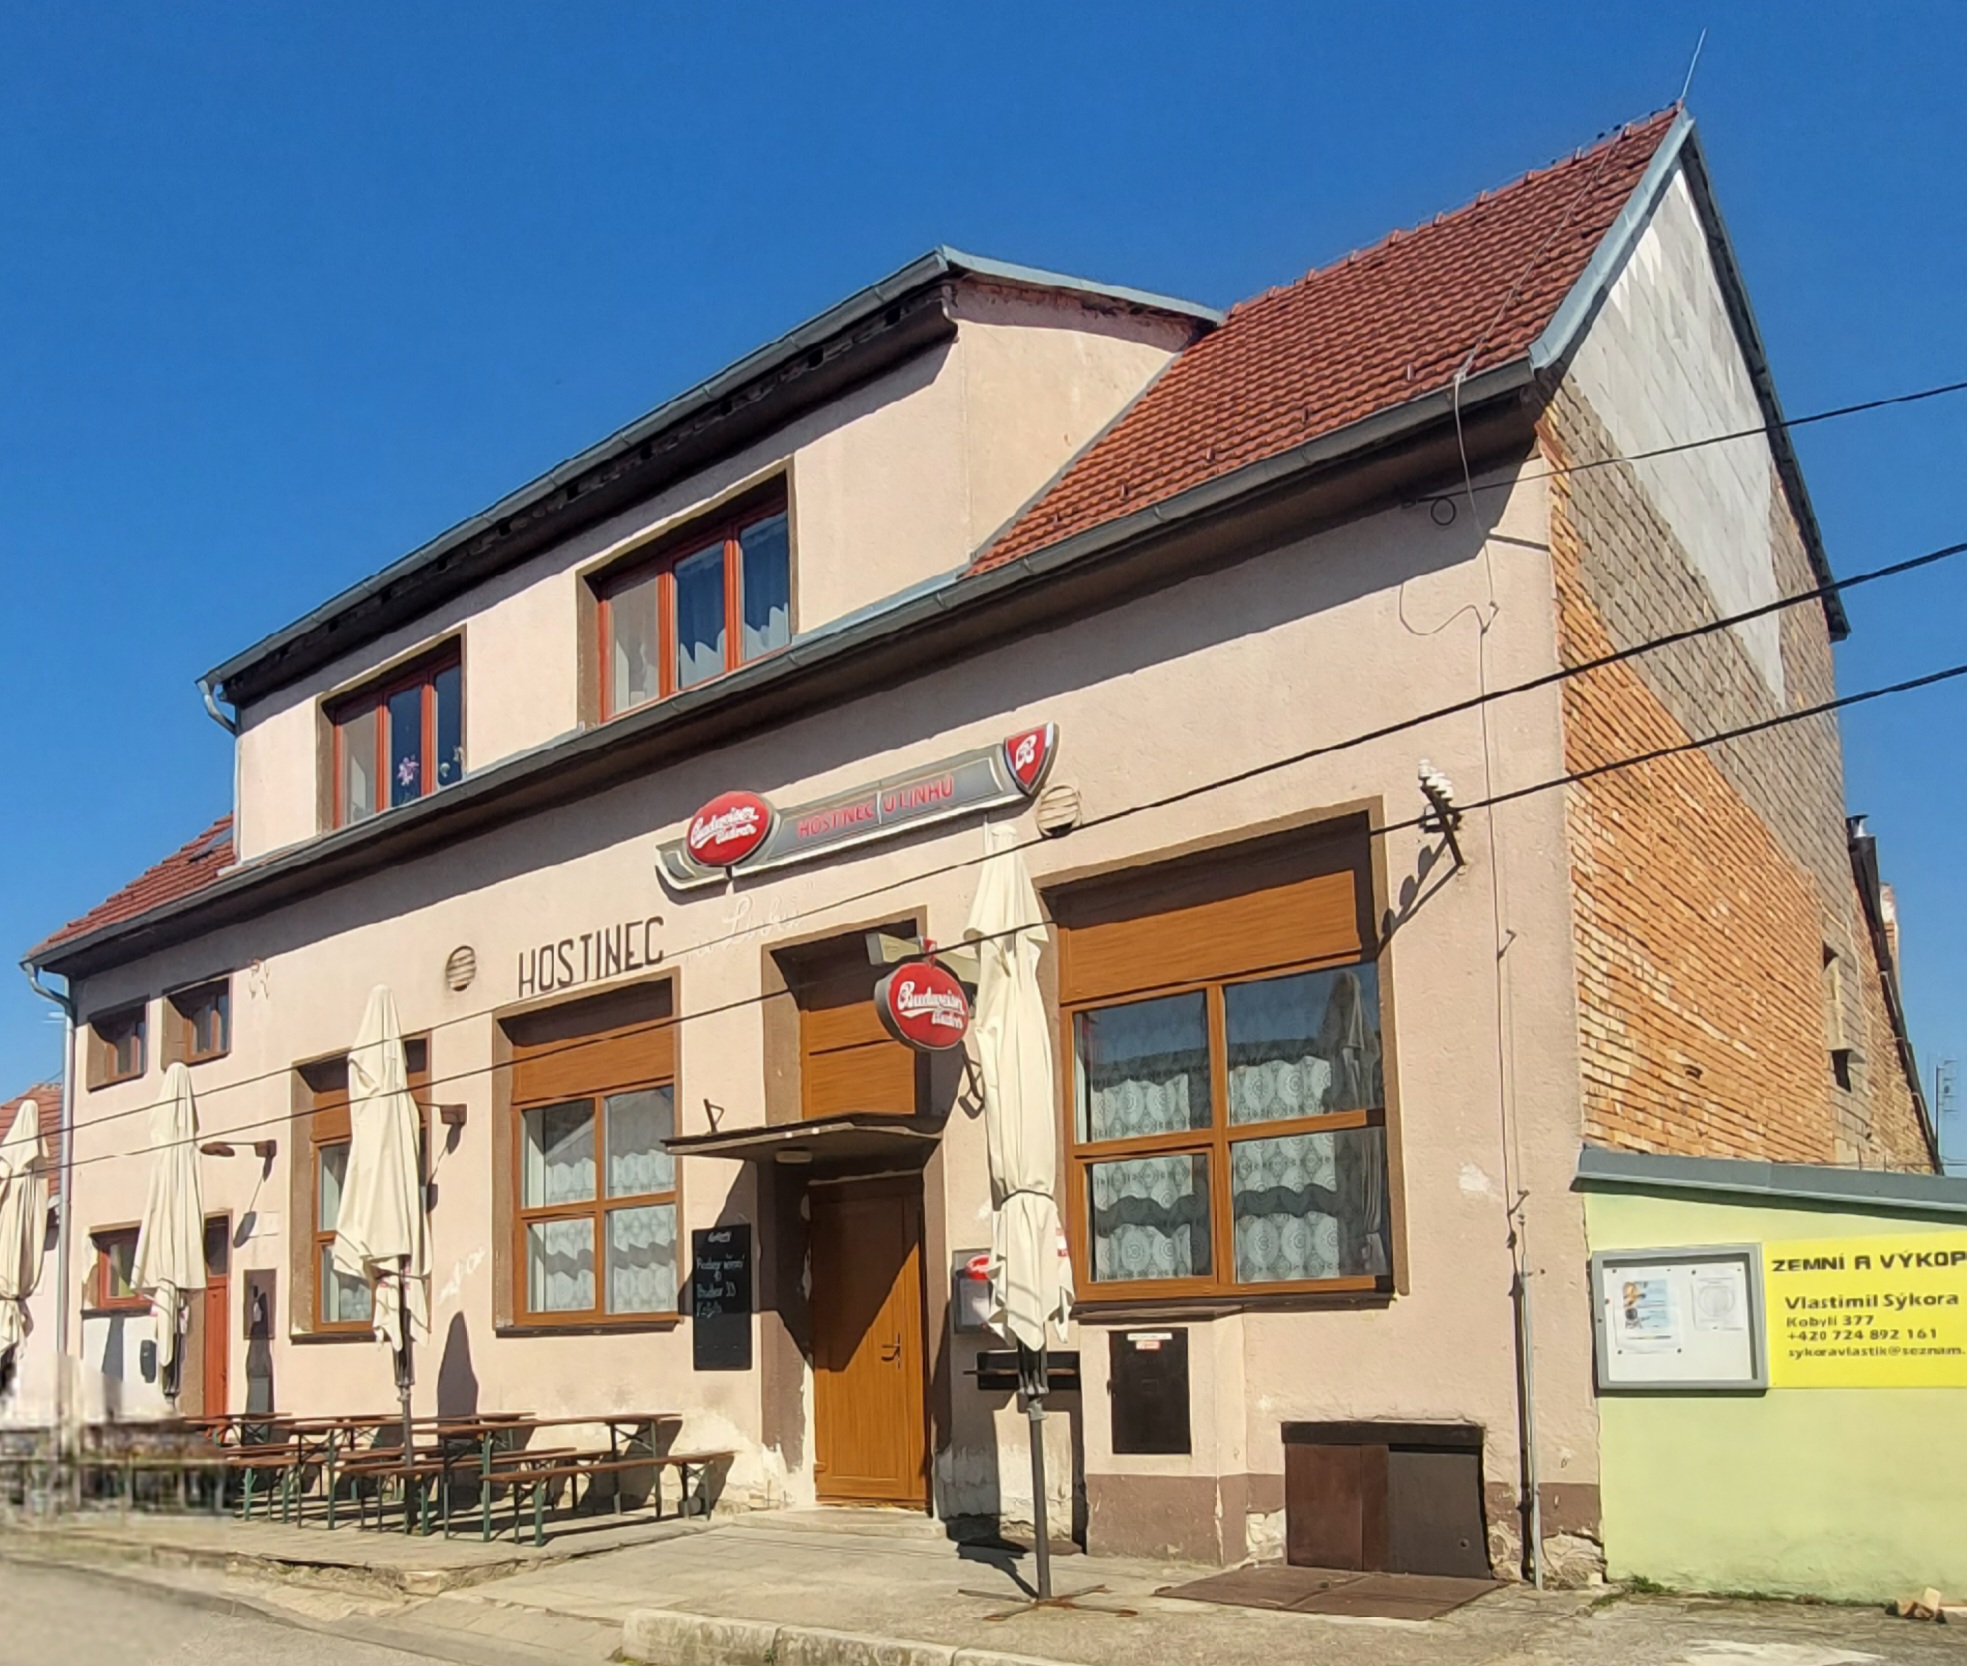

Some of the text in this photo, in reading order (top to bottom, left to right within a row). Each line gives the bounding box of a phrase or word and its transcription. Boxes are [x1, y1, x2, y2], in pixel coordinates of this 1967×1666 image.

[797, 802, 874, 839] HOSTINEC
[883, 795, 896, 812] U
[518, 915, 665, 998] HOSTINEC
[1772, 1253, 1845, 1272] ZEMNÍ
[1785, 1291, 1959, 1311] Vlastimil Sýkora
[1842, 1314, 1874, 1326] 377
[1787, 1327, 1937, 1341] +420 724 892 161
